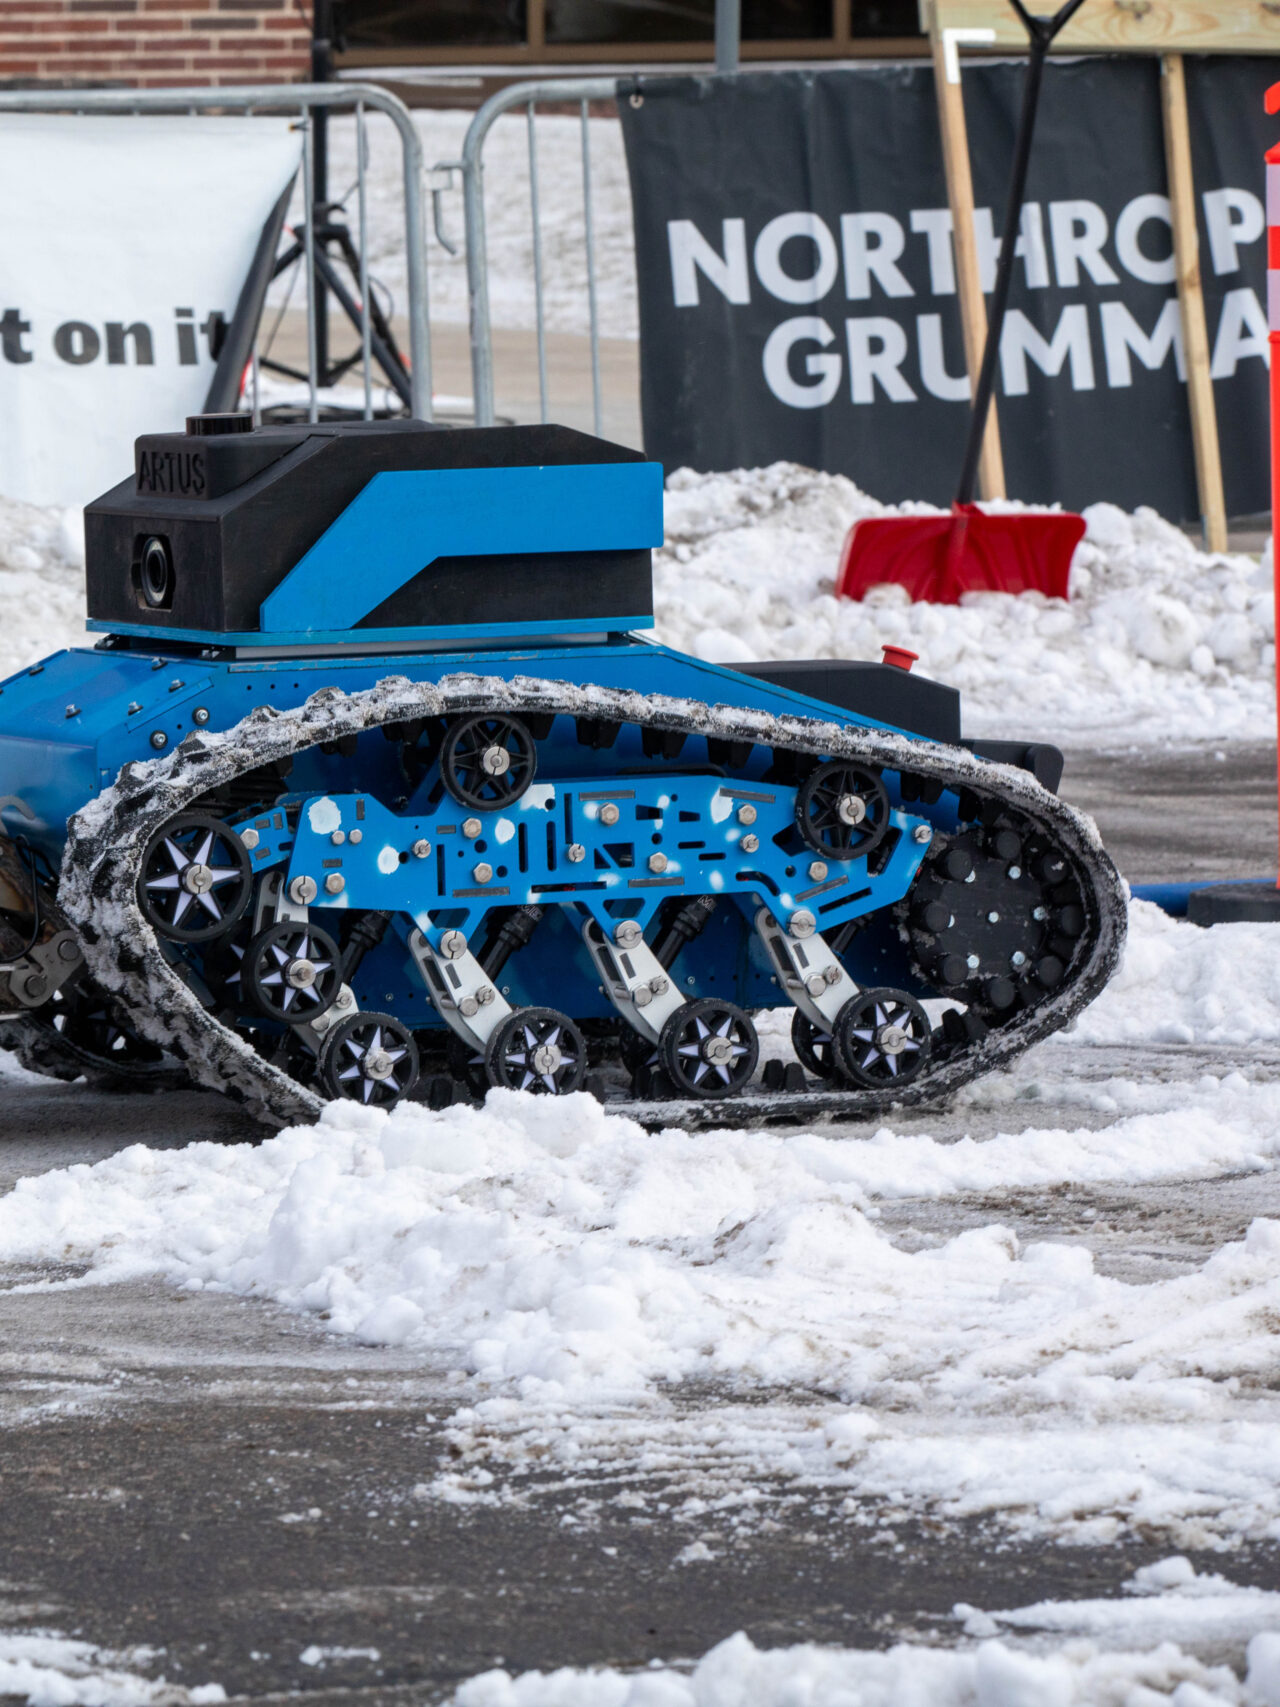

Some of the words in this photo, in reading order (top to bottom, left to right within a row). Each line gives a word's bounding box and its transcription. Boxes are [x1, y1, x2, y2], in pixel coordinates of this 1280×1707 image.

[668, 187, 1266, 306] NORTHROP
[53, 320, 156, 366] on
[175, 308, 231, 367] it
[137, 450, 206, 495] ARTUS
